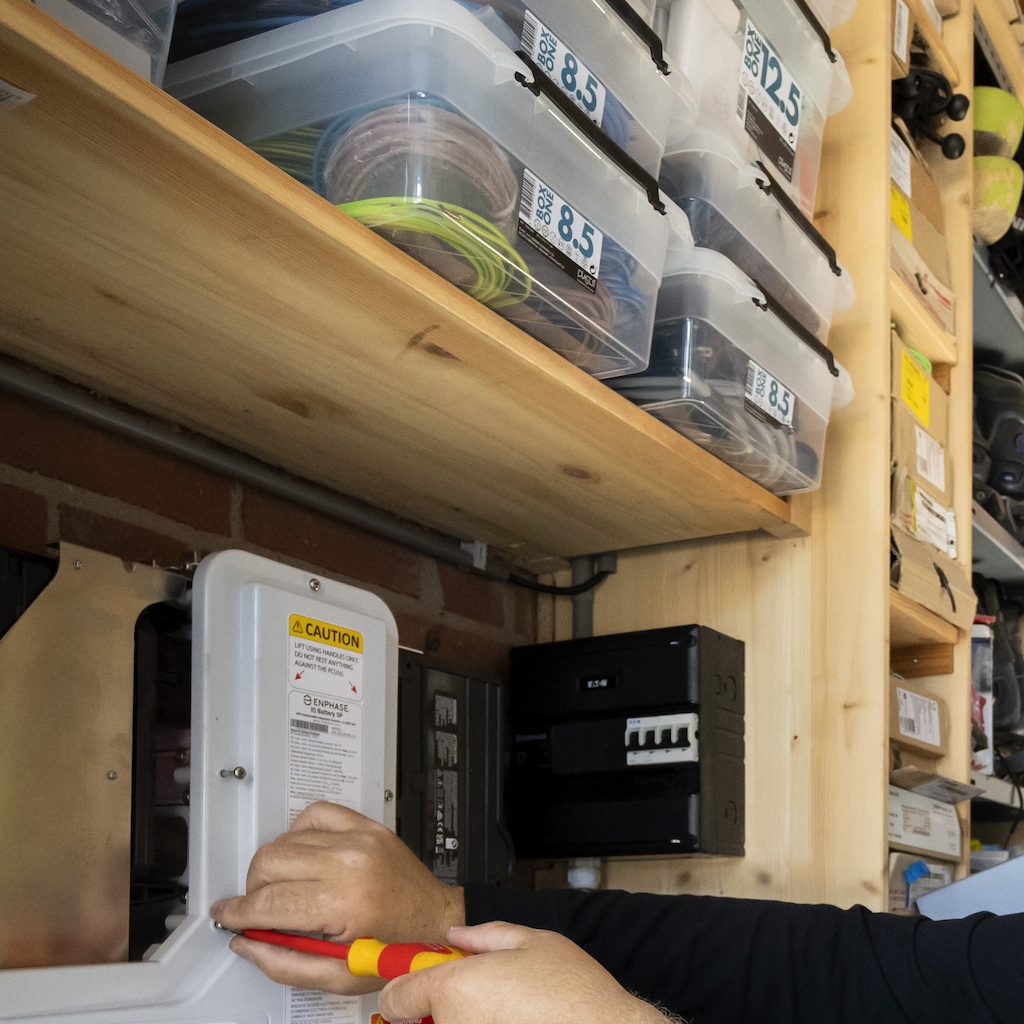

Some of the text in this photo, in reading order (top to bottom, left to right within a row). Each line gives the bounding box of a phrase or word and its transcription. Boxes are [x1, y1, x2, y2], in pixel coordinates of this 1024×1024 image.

[538, 27, 549, 65] BOX
[546, 35, 557, 72] ONE
[744, 23, 754, 70] BOX
[751, 34, 762, 78] ONE
[561, 53, 598, 112] 8.5
[760, 41, 800, 126] 12.5
[536, 184, 546, 220] BOX
[544, 188, 554, 225] ONE
[558, 204, 594, 258] 8.5
[769, 380, 790, 416] 8.5
[306, 623, 360, 648] CAUTION
[294, 660, 316, 670] AGAINST
[323, 649, 345, 660] HANDLES
[328, 660, 353, 670] ANYTHING
[314, 698, 348, 712] ENPHASE
[317, 708, 335, 718] Battery
